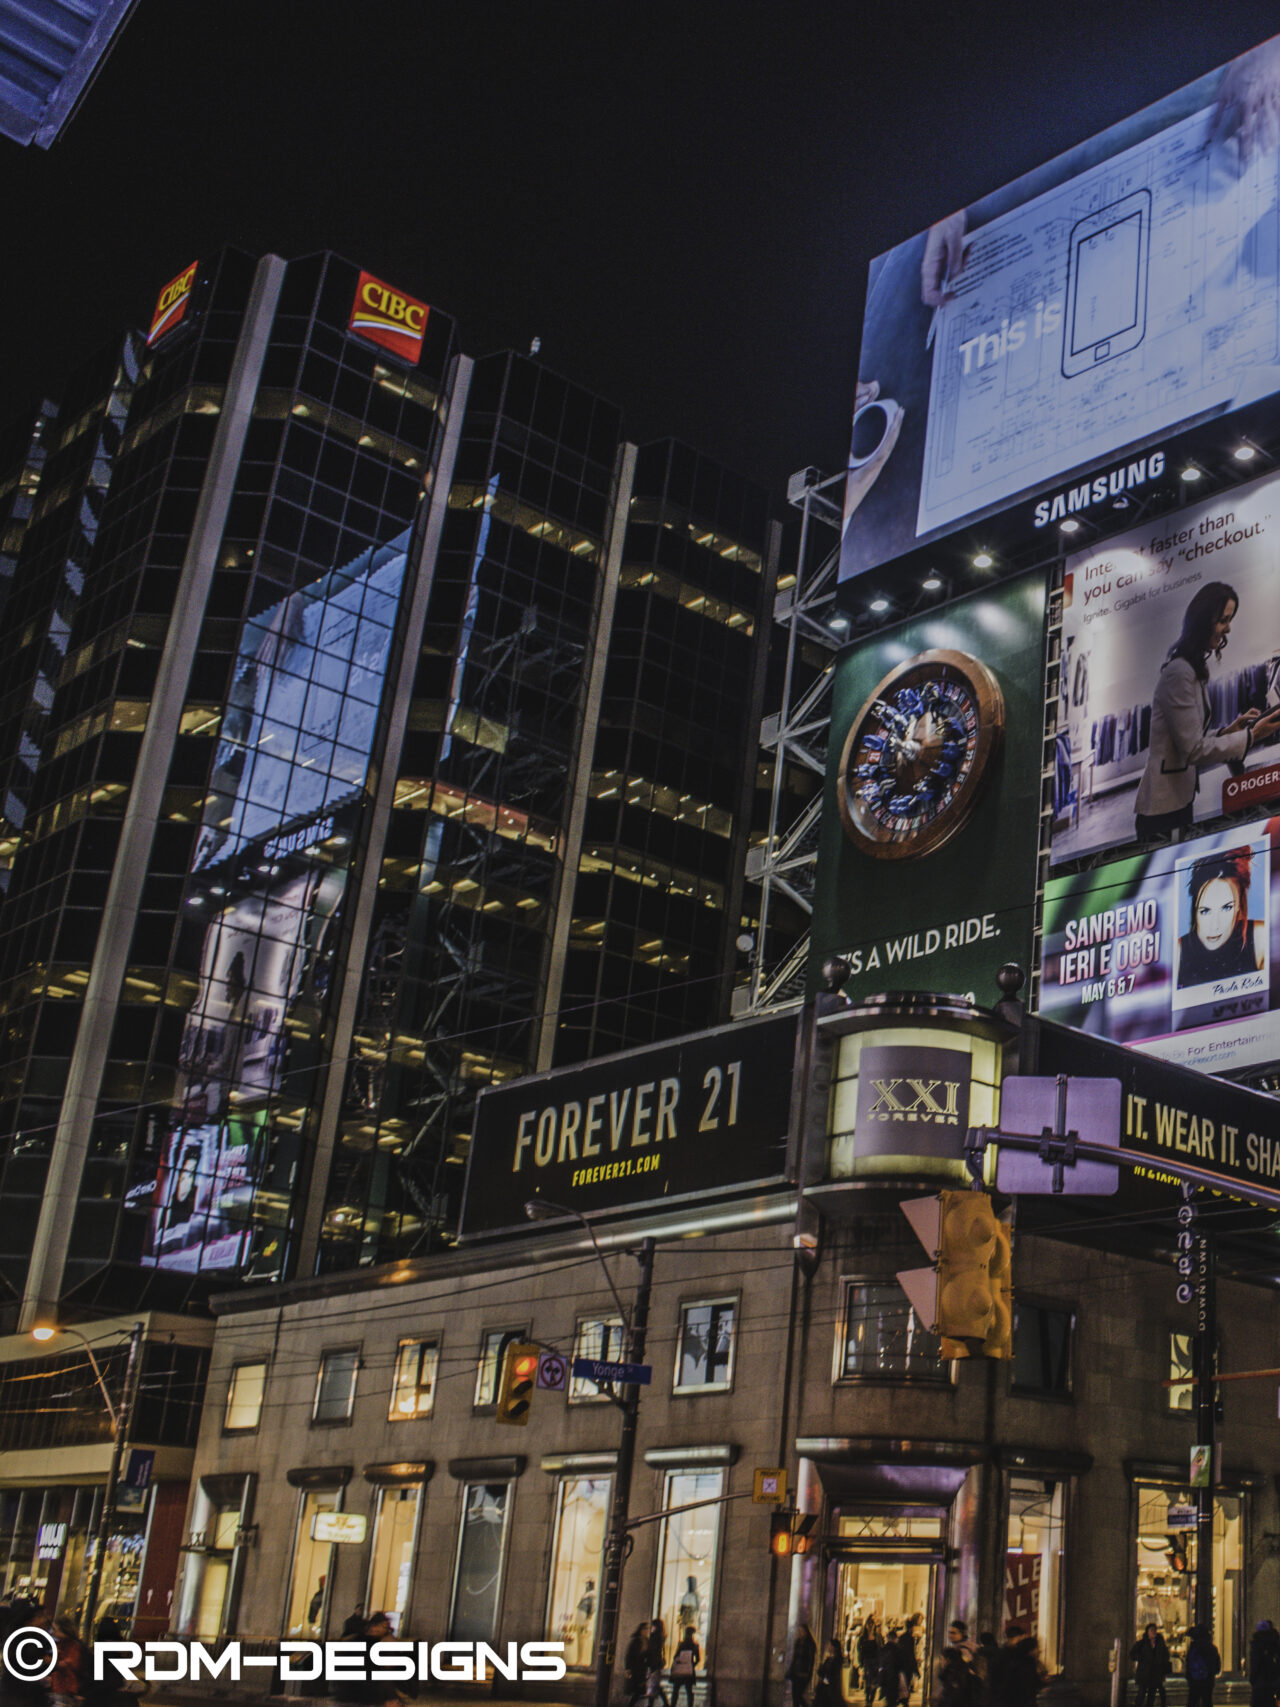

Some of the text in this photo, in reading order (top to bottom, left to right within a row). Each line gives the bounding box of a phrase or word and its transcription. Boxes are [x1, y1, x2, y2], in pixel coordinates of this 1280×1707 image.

[159, 268, 197, 311] CIBC
[362, 283, 425, 330] CIBC
[959, 301, 1062, 375] This is
[1034, 451, 1165, 528] SAMSUNG
[1149, 526, 1196, 555] faster
[1199, 512, 1235, 536] than
[1084, 582, 1111, 606] you
[1163, 572, 1202, 593] business
[866, 946, 881, 972] A
[885, 929, 941, 965] WILD
[944, 913, 1001, 950] RIDE.
[1064, 899, 1157, 951] SANREMO
[1059, 931, 1161, 986] IERI E OGGI
[1081, 974, 1136, 1004] MAY 6 & 7
[1187, 1046, 1206, 1057] For
[513, 1060, 742, 1173] FOREVER 21
[868, 1078, 961, 1116] XXI
[866, 1112, 960, 1126] FOREVER
[1126, 1093, 1149, 1141] IT.
[1155, 1102, 1215, 1160] WEAR
[1220, 1123, 1241, 1168] IT.
[571, 1153, 661, 1188] FOREVER21.COM
[1199, 1238, 1207, 1331] DOWNTOWN
[592, 1362, 625, 1378] Yonge
